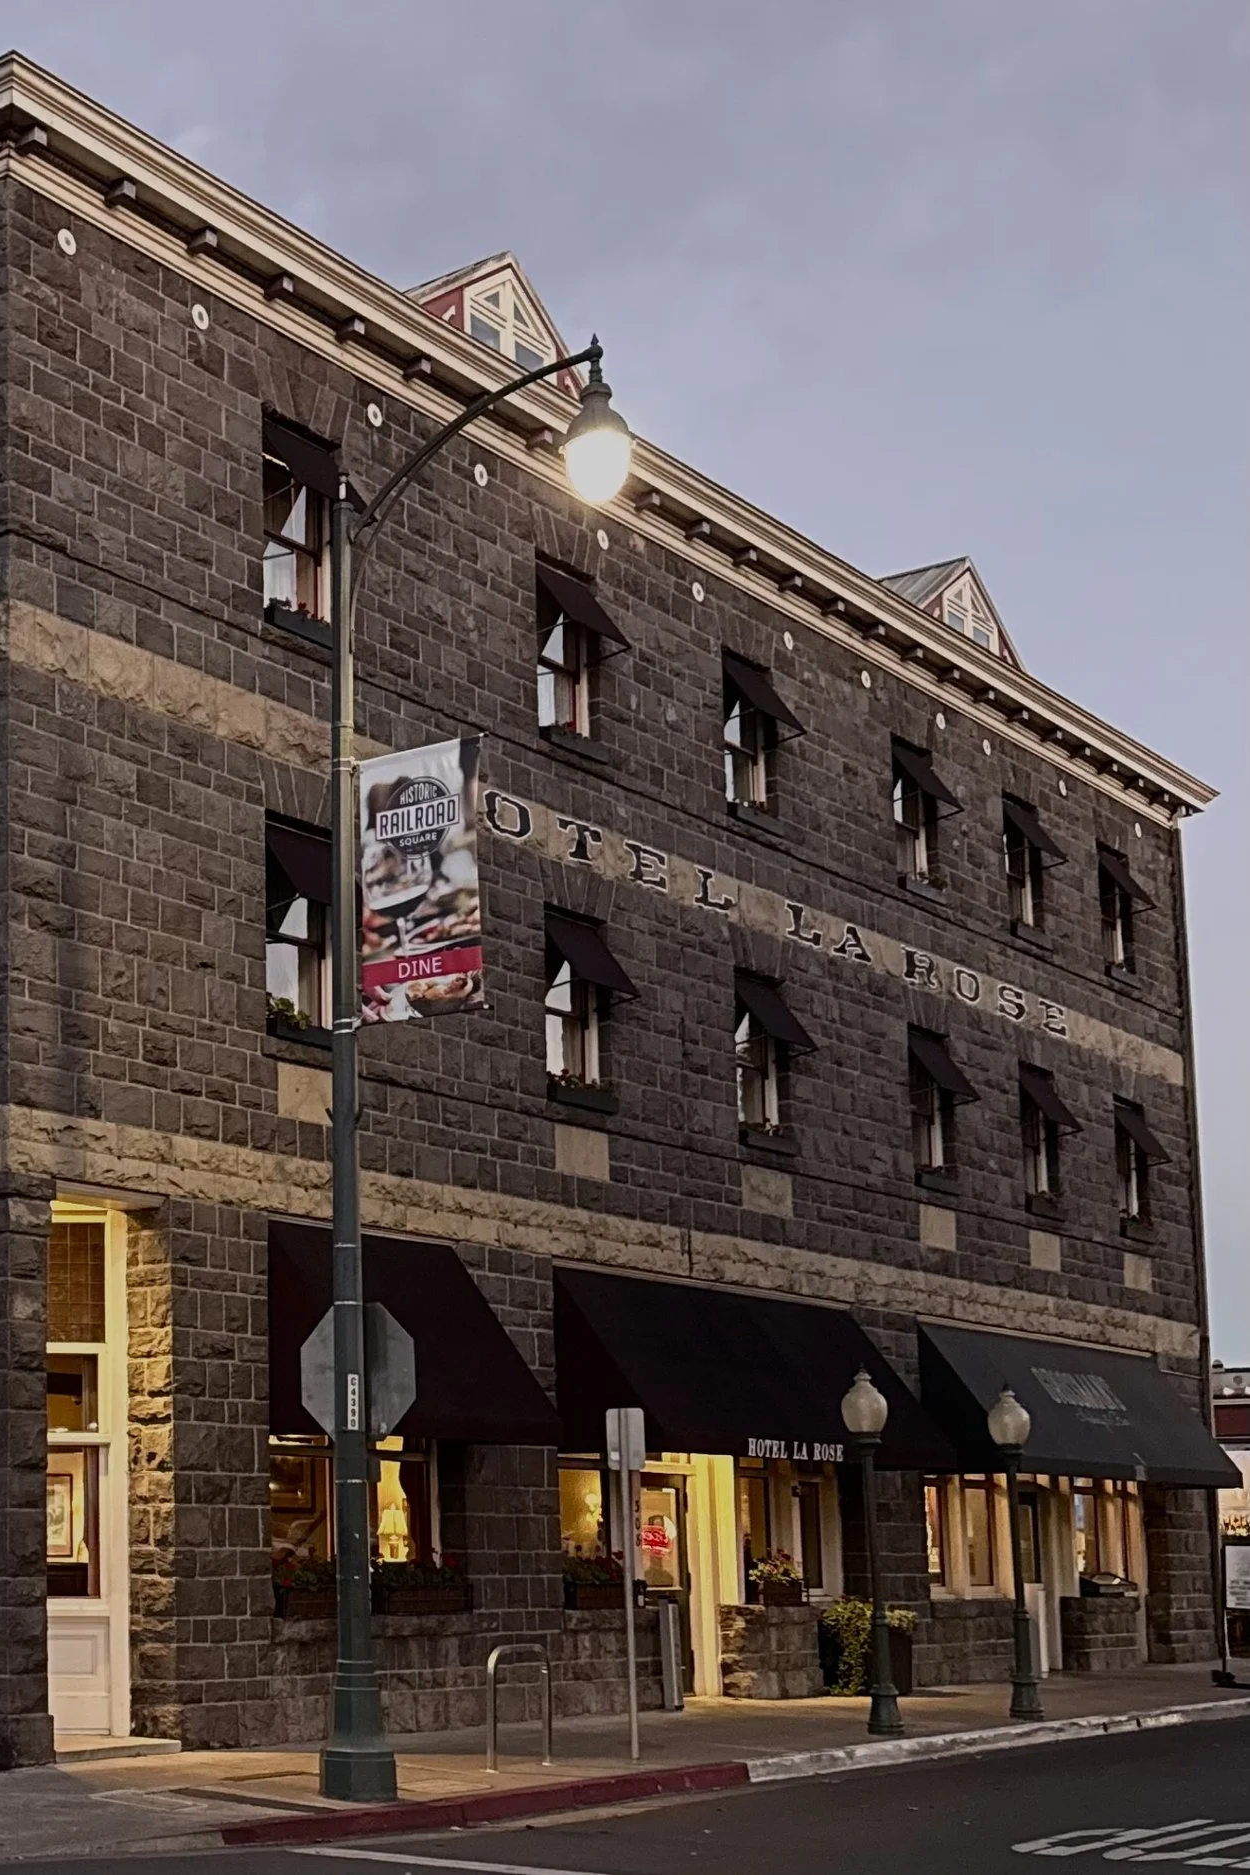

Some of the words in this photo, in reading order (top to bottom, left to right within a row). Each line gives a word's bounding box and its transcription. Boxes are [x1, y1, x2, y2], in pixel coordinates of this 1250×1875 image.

[399, 782, 438, 805] HISTORIC
[380, 799, 456, 837] RAILROAD
[399, 832, 437, 847] SQUARE
[483, 789, 737, 914] OTEL
[784, 900, 872, 966] LA
[901, 943, 1069, 1039] ROSE
[398, 956, 442, 979] DINE
[748, 1438, 788, 1458] HOTEL
[793, 1441, 808, 1460] LA
[813, 1443, 844, 1462] ROSE
